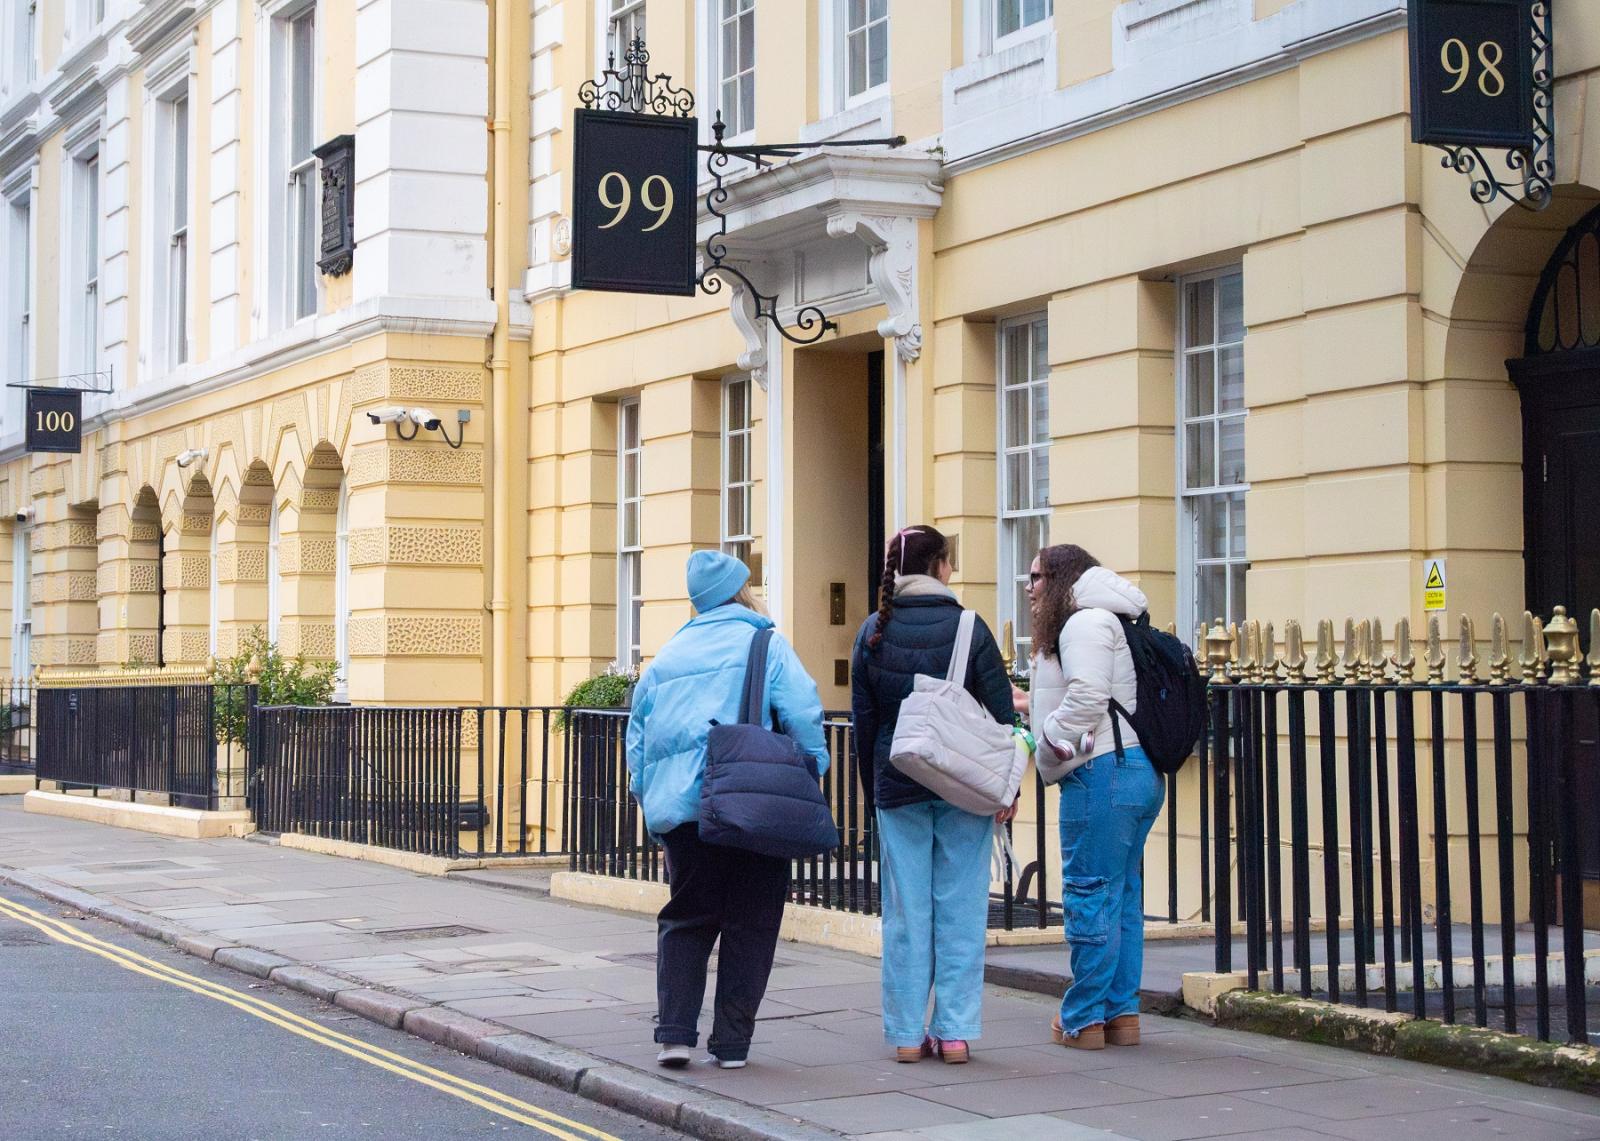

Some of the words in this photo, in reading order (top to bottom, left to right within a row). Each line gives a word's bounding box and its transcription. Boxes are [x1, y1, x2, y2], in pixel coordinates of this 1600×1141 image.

[1440, 38, 1505, 97] 98
[598, 171, 674, 232] 99
[36, 410, 75, 432] 100
